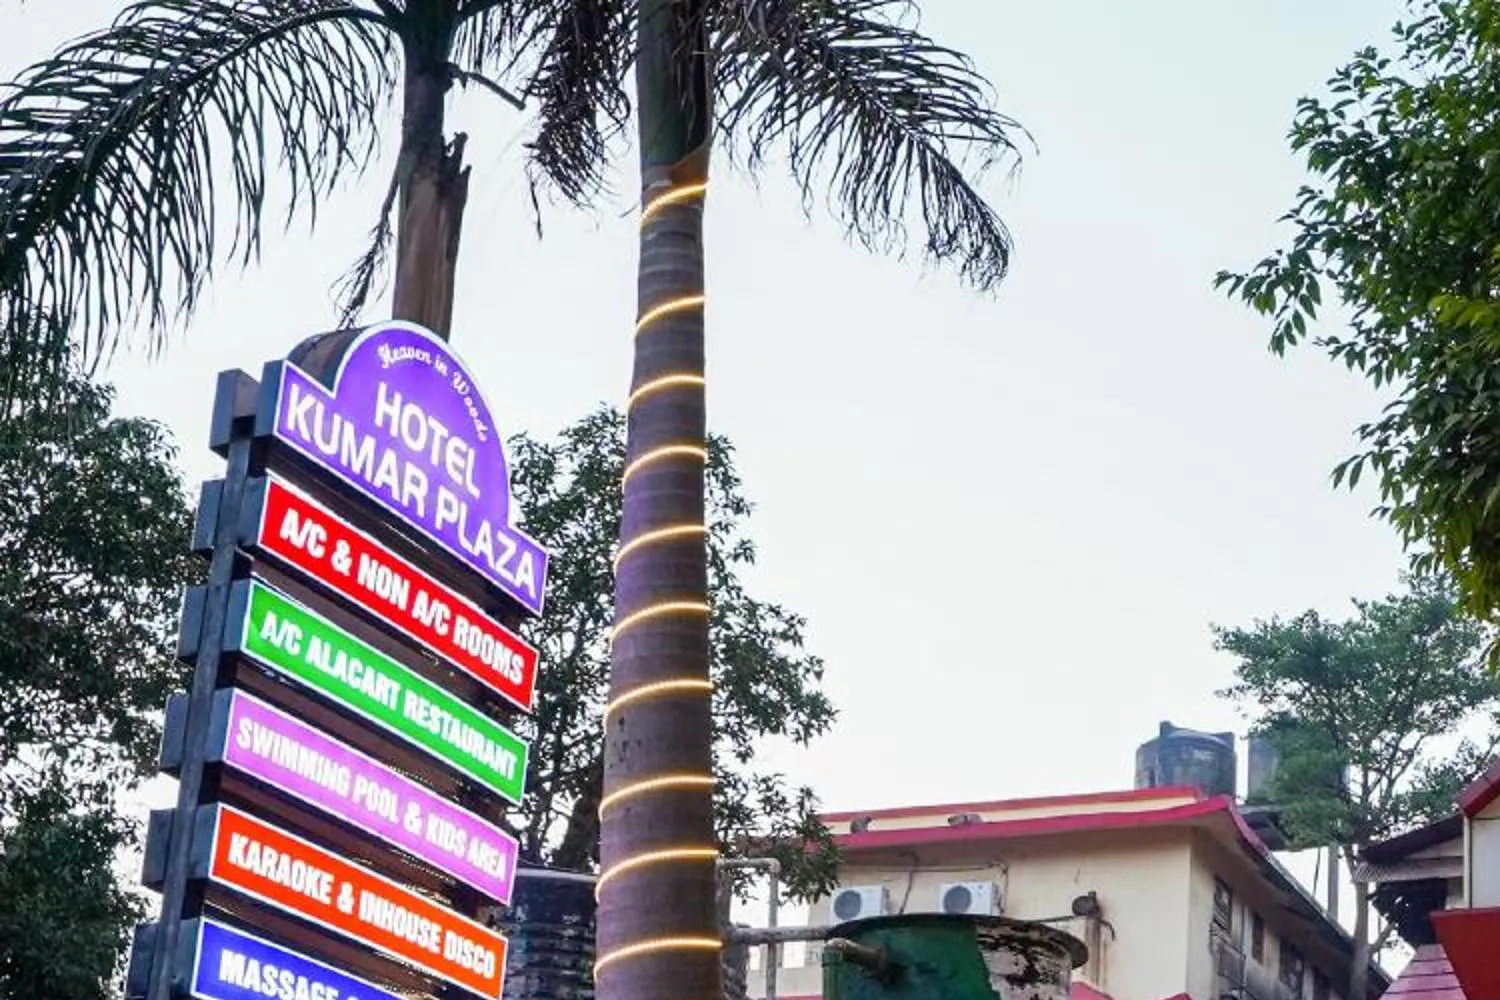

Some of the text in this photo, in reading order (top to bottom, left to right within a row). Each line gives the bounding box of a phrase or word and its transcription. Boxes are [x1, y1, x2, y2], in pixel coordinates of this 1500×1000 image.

[374, 381, 481, 498] HOTEL
[435, 354, 449, 376] in
[286, 382, 537, 600] KUMAR PLAZA
[279, 506, 525, 687] A/C & NON A/C ROOMS
[260, 610, 519, 780] A/C ALACART RESTAURANT
[236, 716, 506, 881] SWIMMING POOL & KIDS AREA
[227, 832, 496, 980] KARAOKE & INHOUSE DISCO
